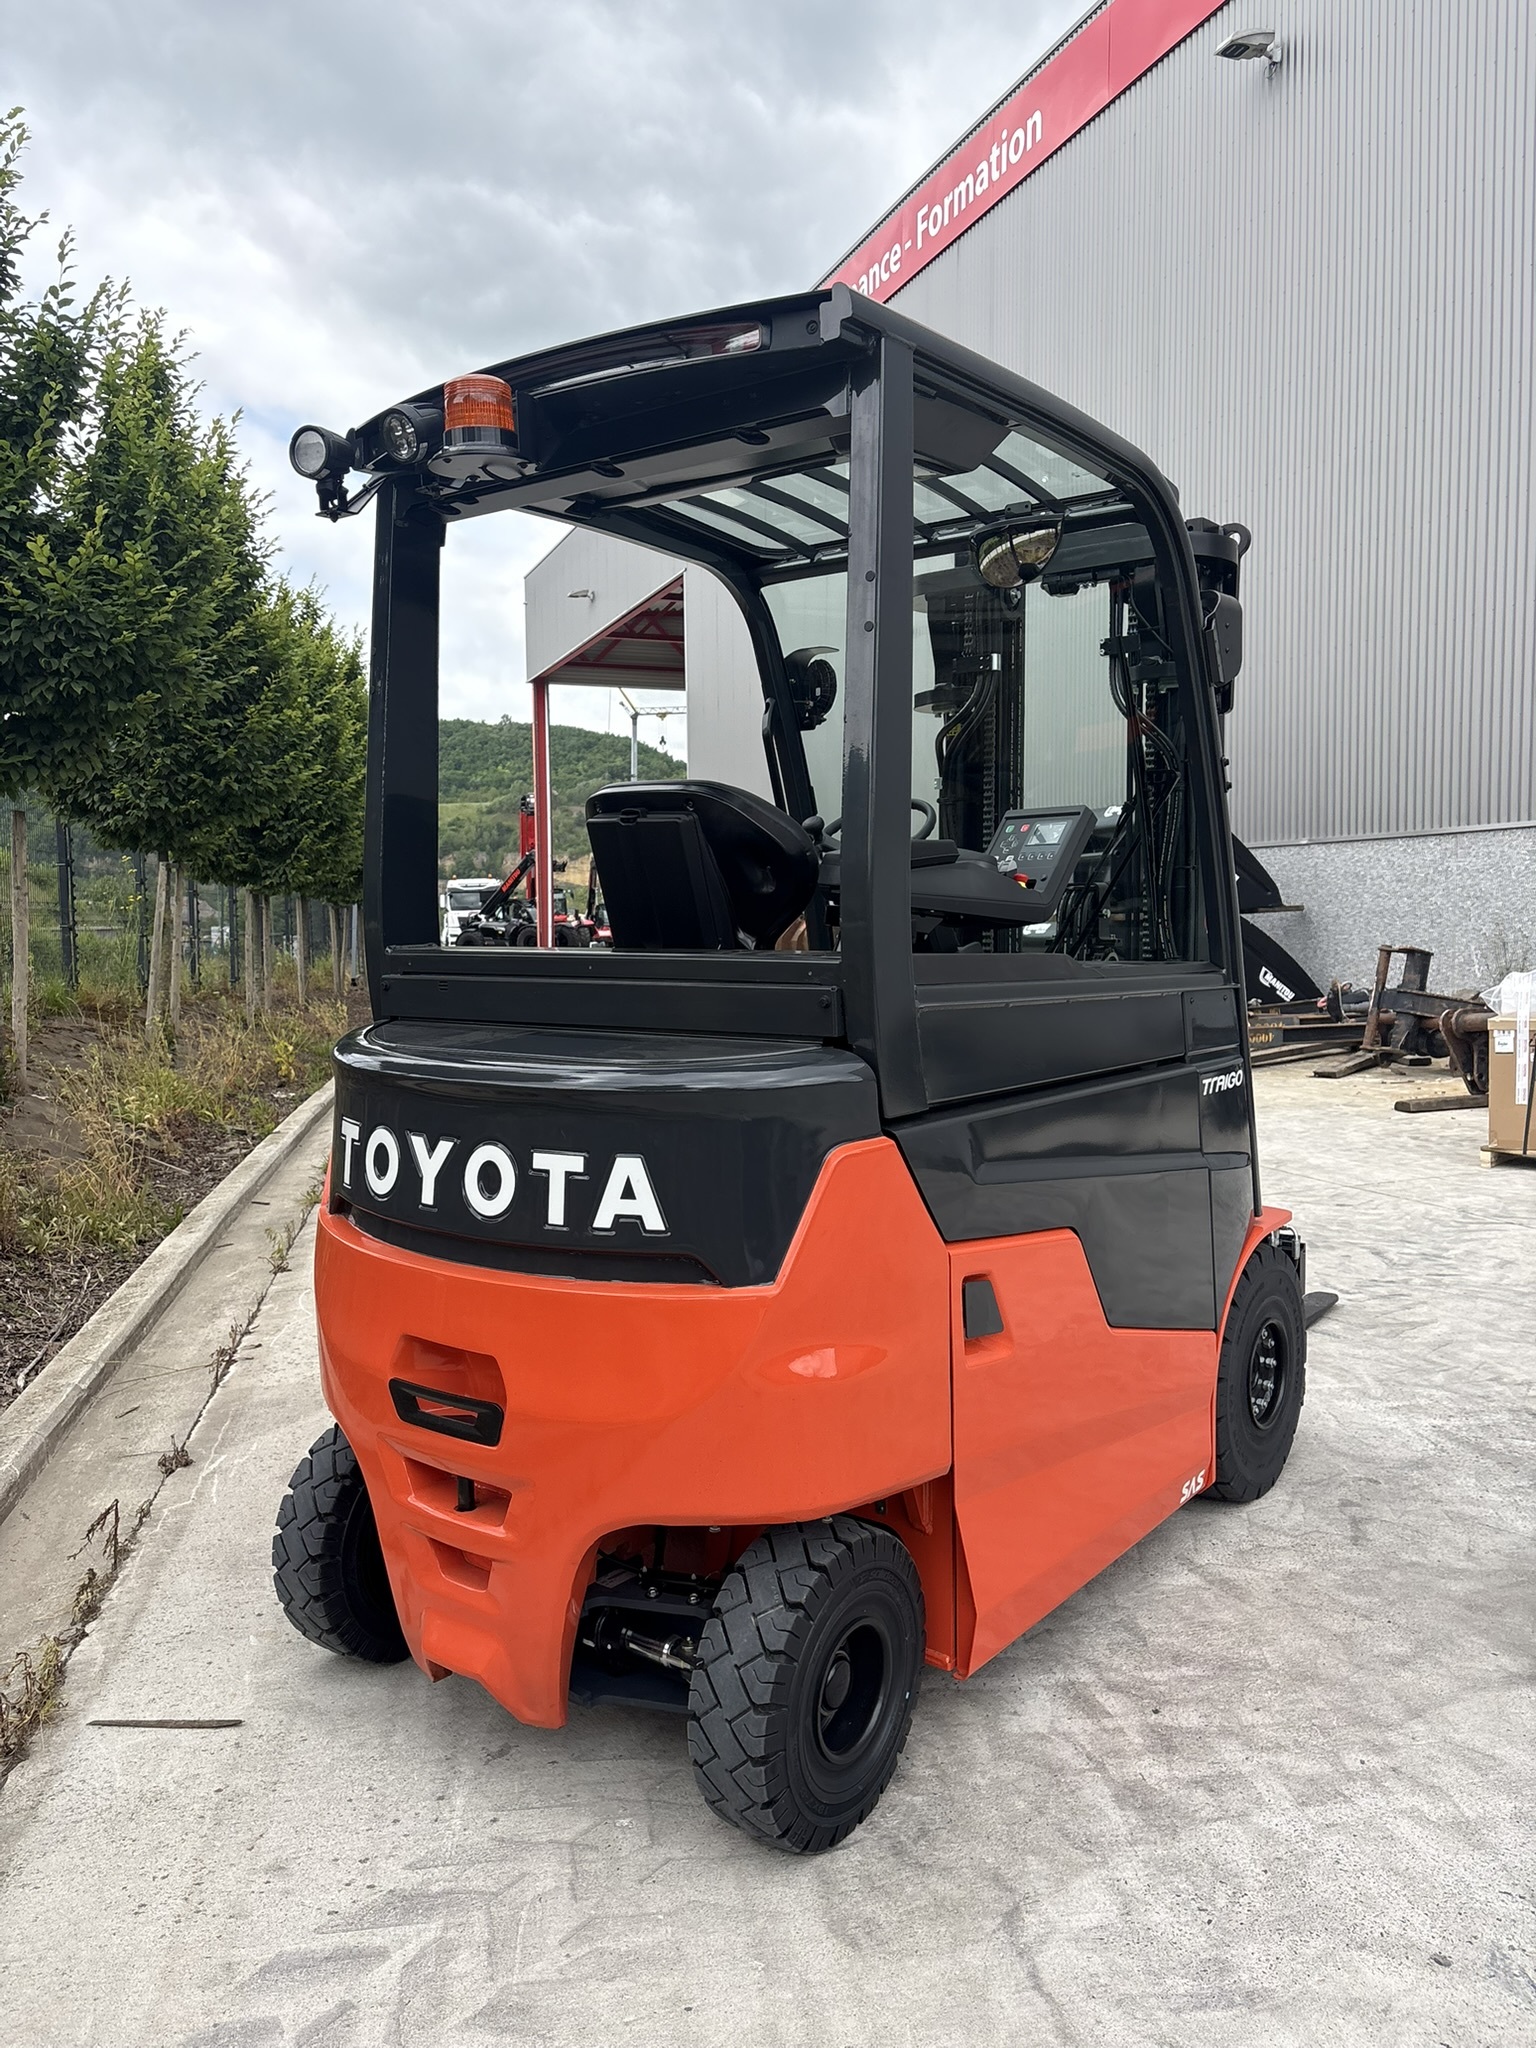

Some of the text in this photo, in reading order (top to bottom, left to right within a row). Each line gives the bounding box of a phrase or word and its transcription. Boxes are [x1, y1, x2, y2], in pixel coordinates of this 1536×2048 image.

[917, 110, 1042, 250] Formation
[1262, 969, 1295, 1000] MANITOU
[341, 1118, 667, 1232] TOYOTA
[1180, 1469, 1205, 1503] SAS
